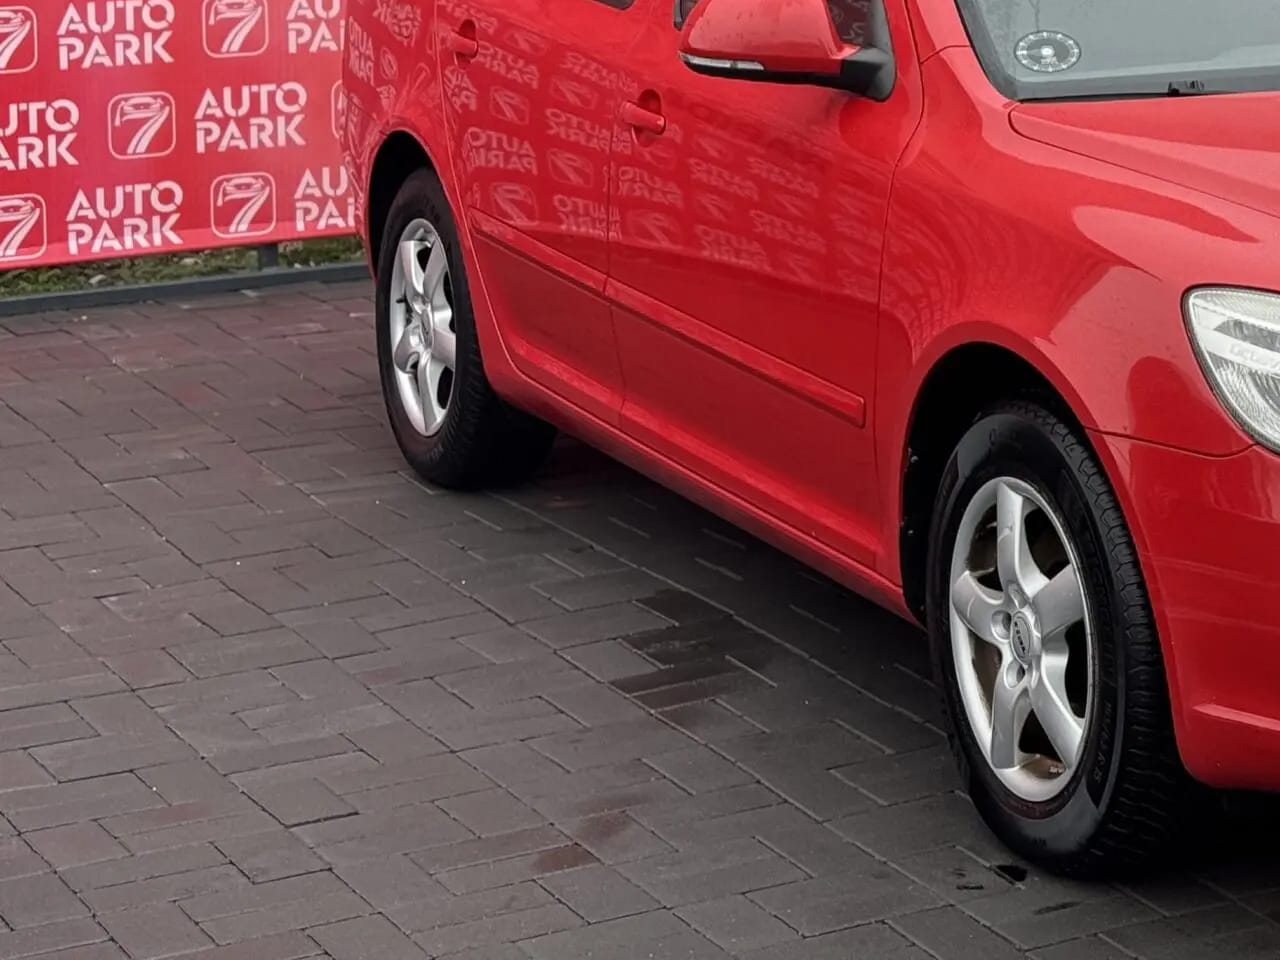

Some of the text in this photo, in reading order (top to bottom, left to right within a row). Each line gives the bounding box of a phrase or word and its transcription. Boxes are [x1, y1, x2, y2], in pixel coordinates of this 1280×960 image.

[58, 31, 174, 71] PARK
[288, 22, 344, 54] PA
[0, 99, 79, 137] UTO
[194, 82, 307, 120] AUTO
[196, 115, 306, 153] PARK
[66, 181, 183, 221] AUTO
[294, 168, 349, 199] AU
[67, 214, 183, 255] PARK
